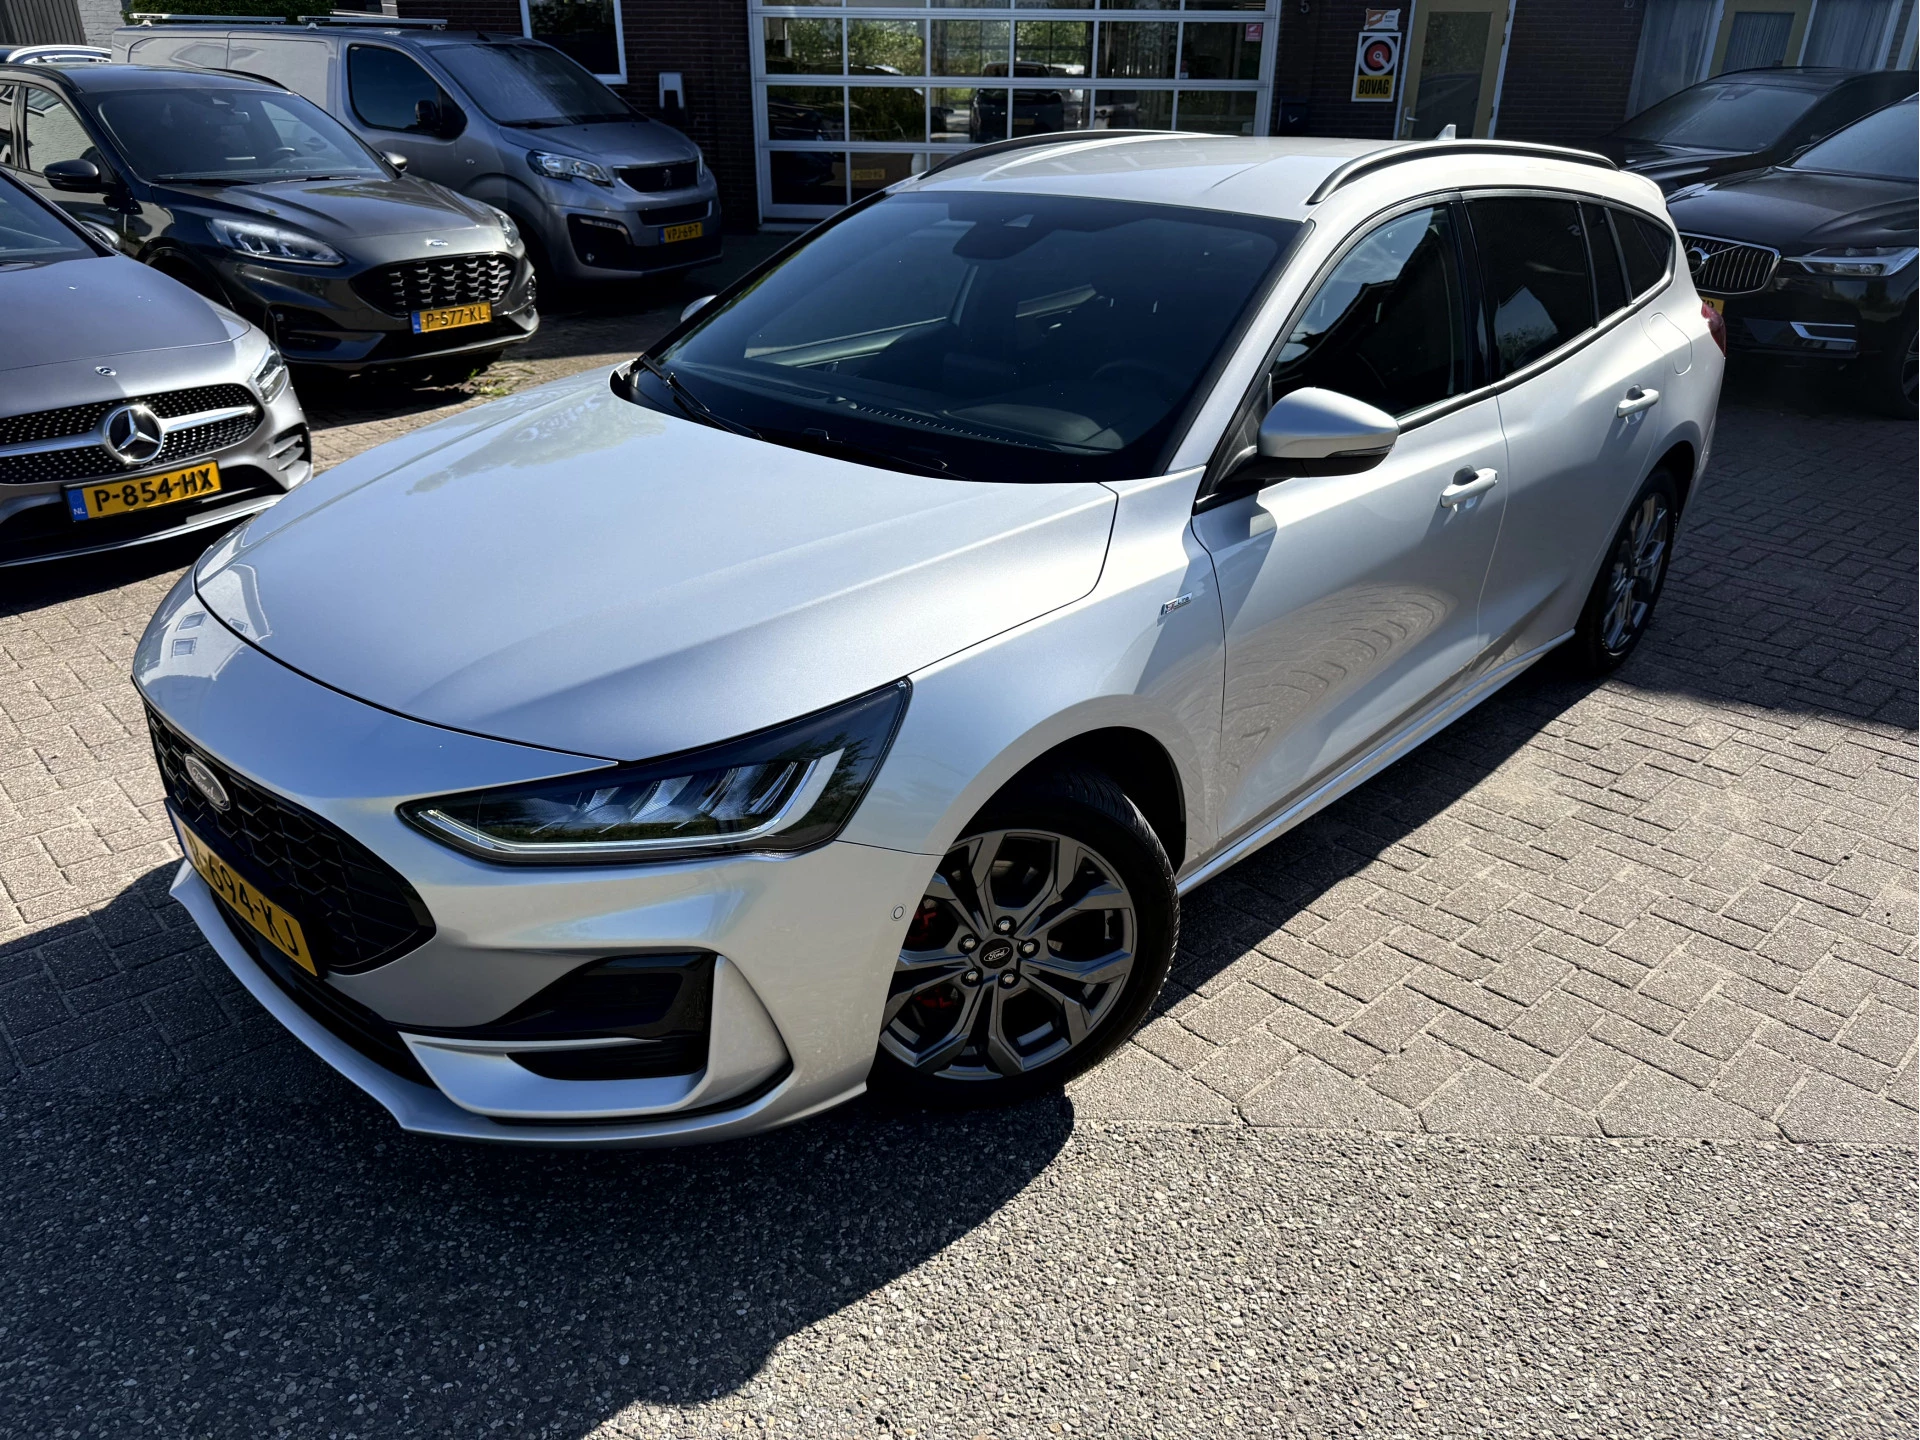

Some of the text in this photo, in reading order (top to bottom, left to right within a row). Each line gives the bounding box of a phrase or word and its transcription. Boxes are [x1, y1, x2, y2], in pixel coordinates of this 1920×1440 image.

[1358, 79, 1390, 95] BOVAG
[666, 224, 699, 240] VPJ-69-T
[426, 306, 487, 329] P-577-KL
[93, 468, 214, 512] P-854-HX
[73, 508, 86, 516] NL
[988, 949, 1005, 960] Ford
